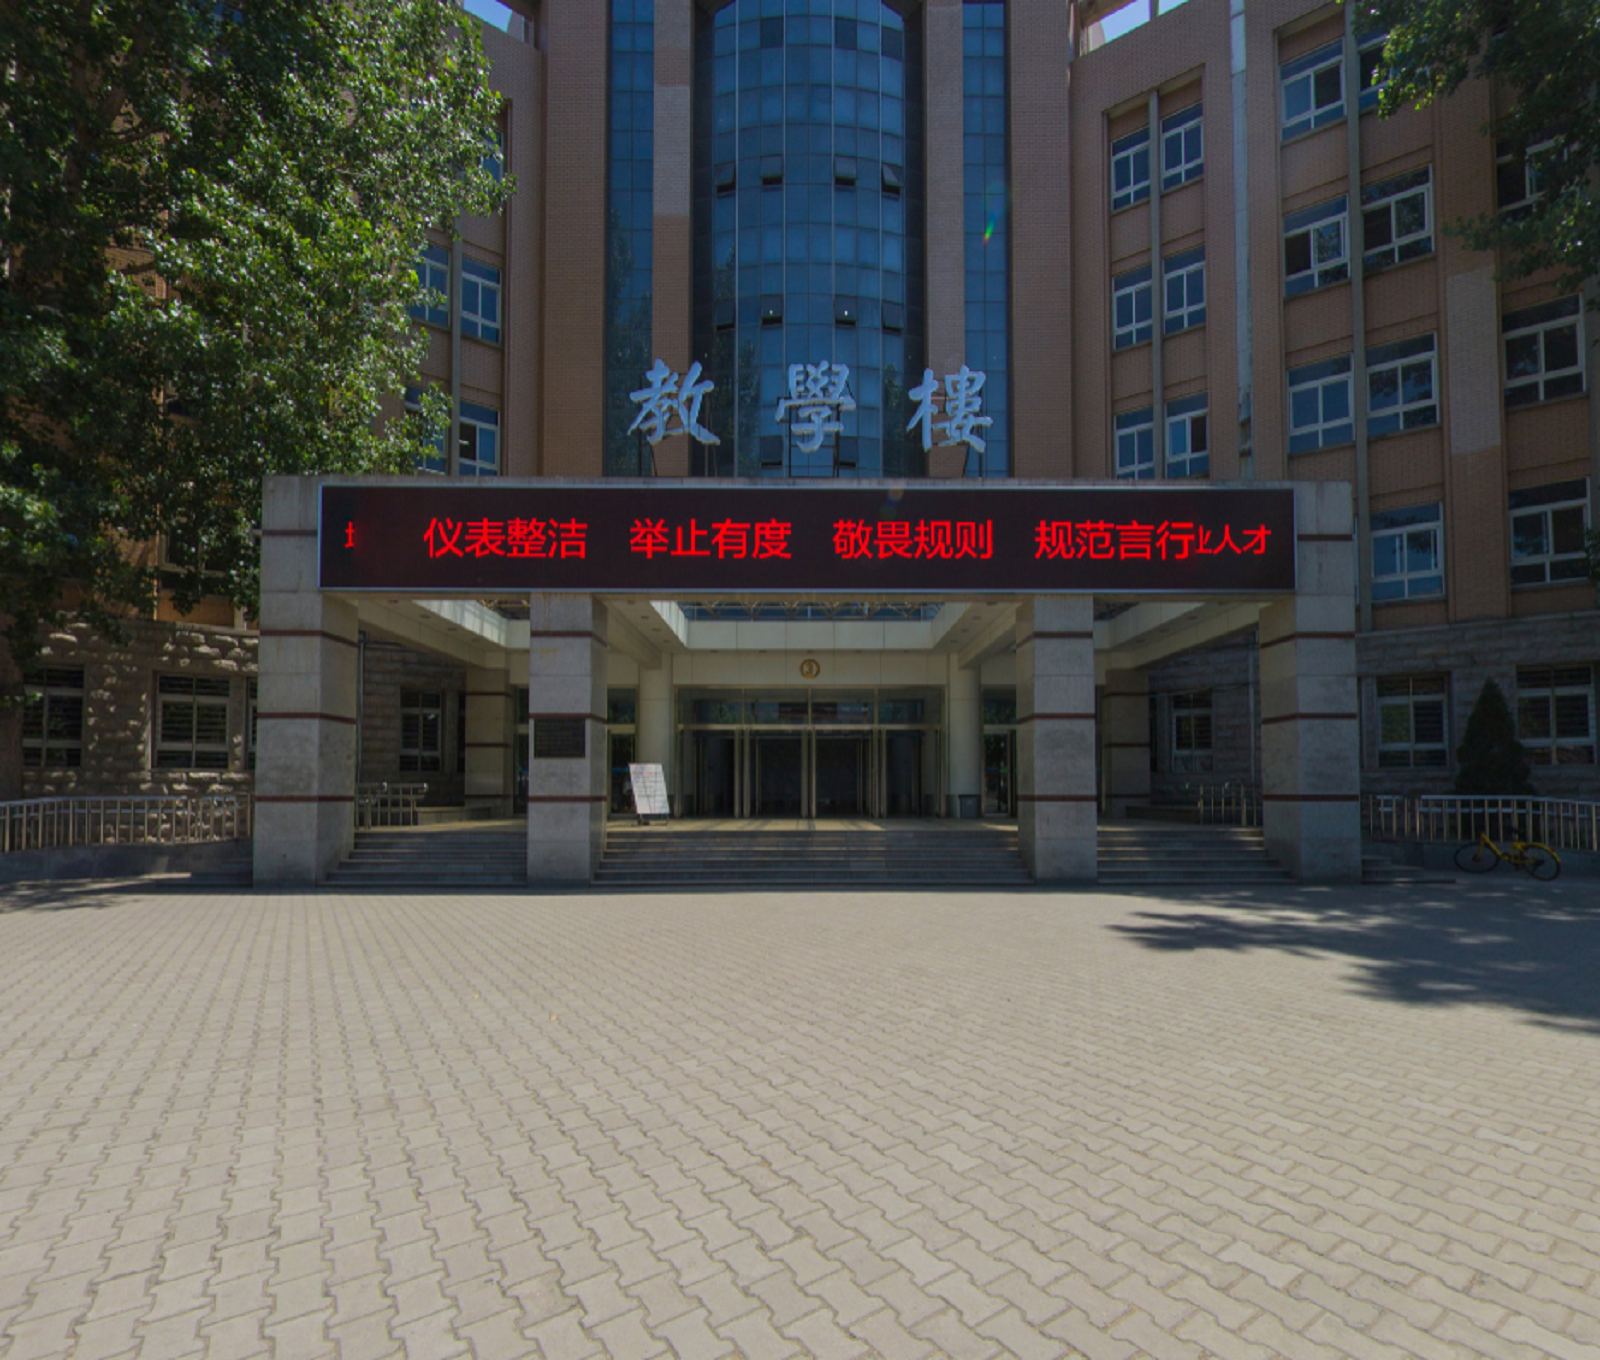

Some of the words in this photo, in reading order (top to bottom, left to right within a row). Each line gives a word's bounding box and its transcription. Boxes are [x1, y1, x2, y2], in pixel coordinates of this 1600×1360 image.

[626, 358, 993, 454] 教學樓
[423, 517, 588, 559] 仪表整洁
[630, 518, 791, 559] 举止有度
[833, 519, 993, 560] 敬畏规则
[1035, 519, 1195, 560] 规范言行
